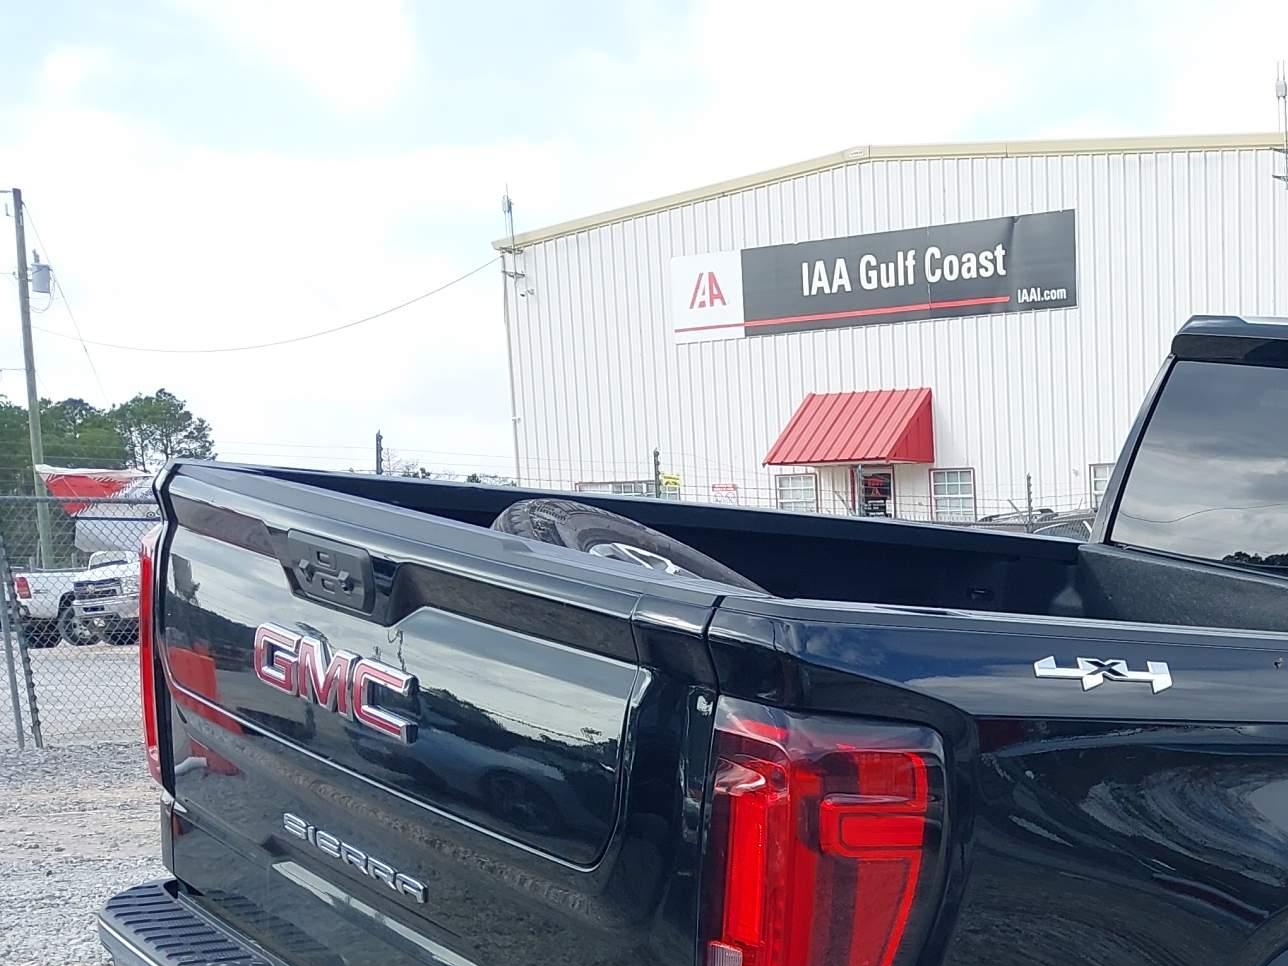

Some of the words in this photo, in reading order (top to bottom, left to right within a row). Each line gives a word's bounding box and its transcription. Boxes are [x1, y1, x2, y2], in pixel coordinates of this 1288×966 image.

[801, 259, 851, 297] IAA
[858, 249, 917, 291] Gulf
[924, 243, 1007, 283] Coast
[1016, 287, 1067, 304] IAAI.com
[253, 621, 419, 745] GMC
[284, 812, 428, 904] SIERRA
